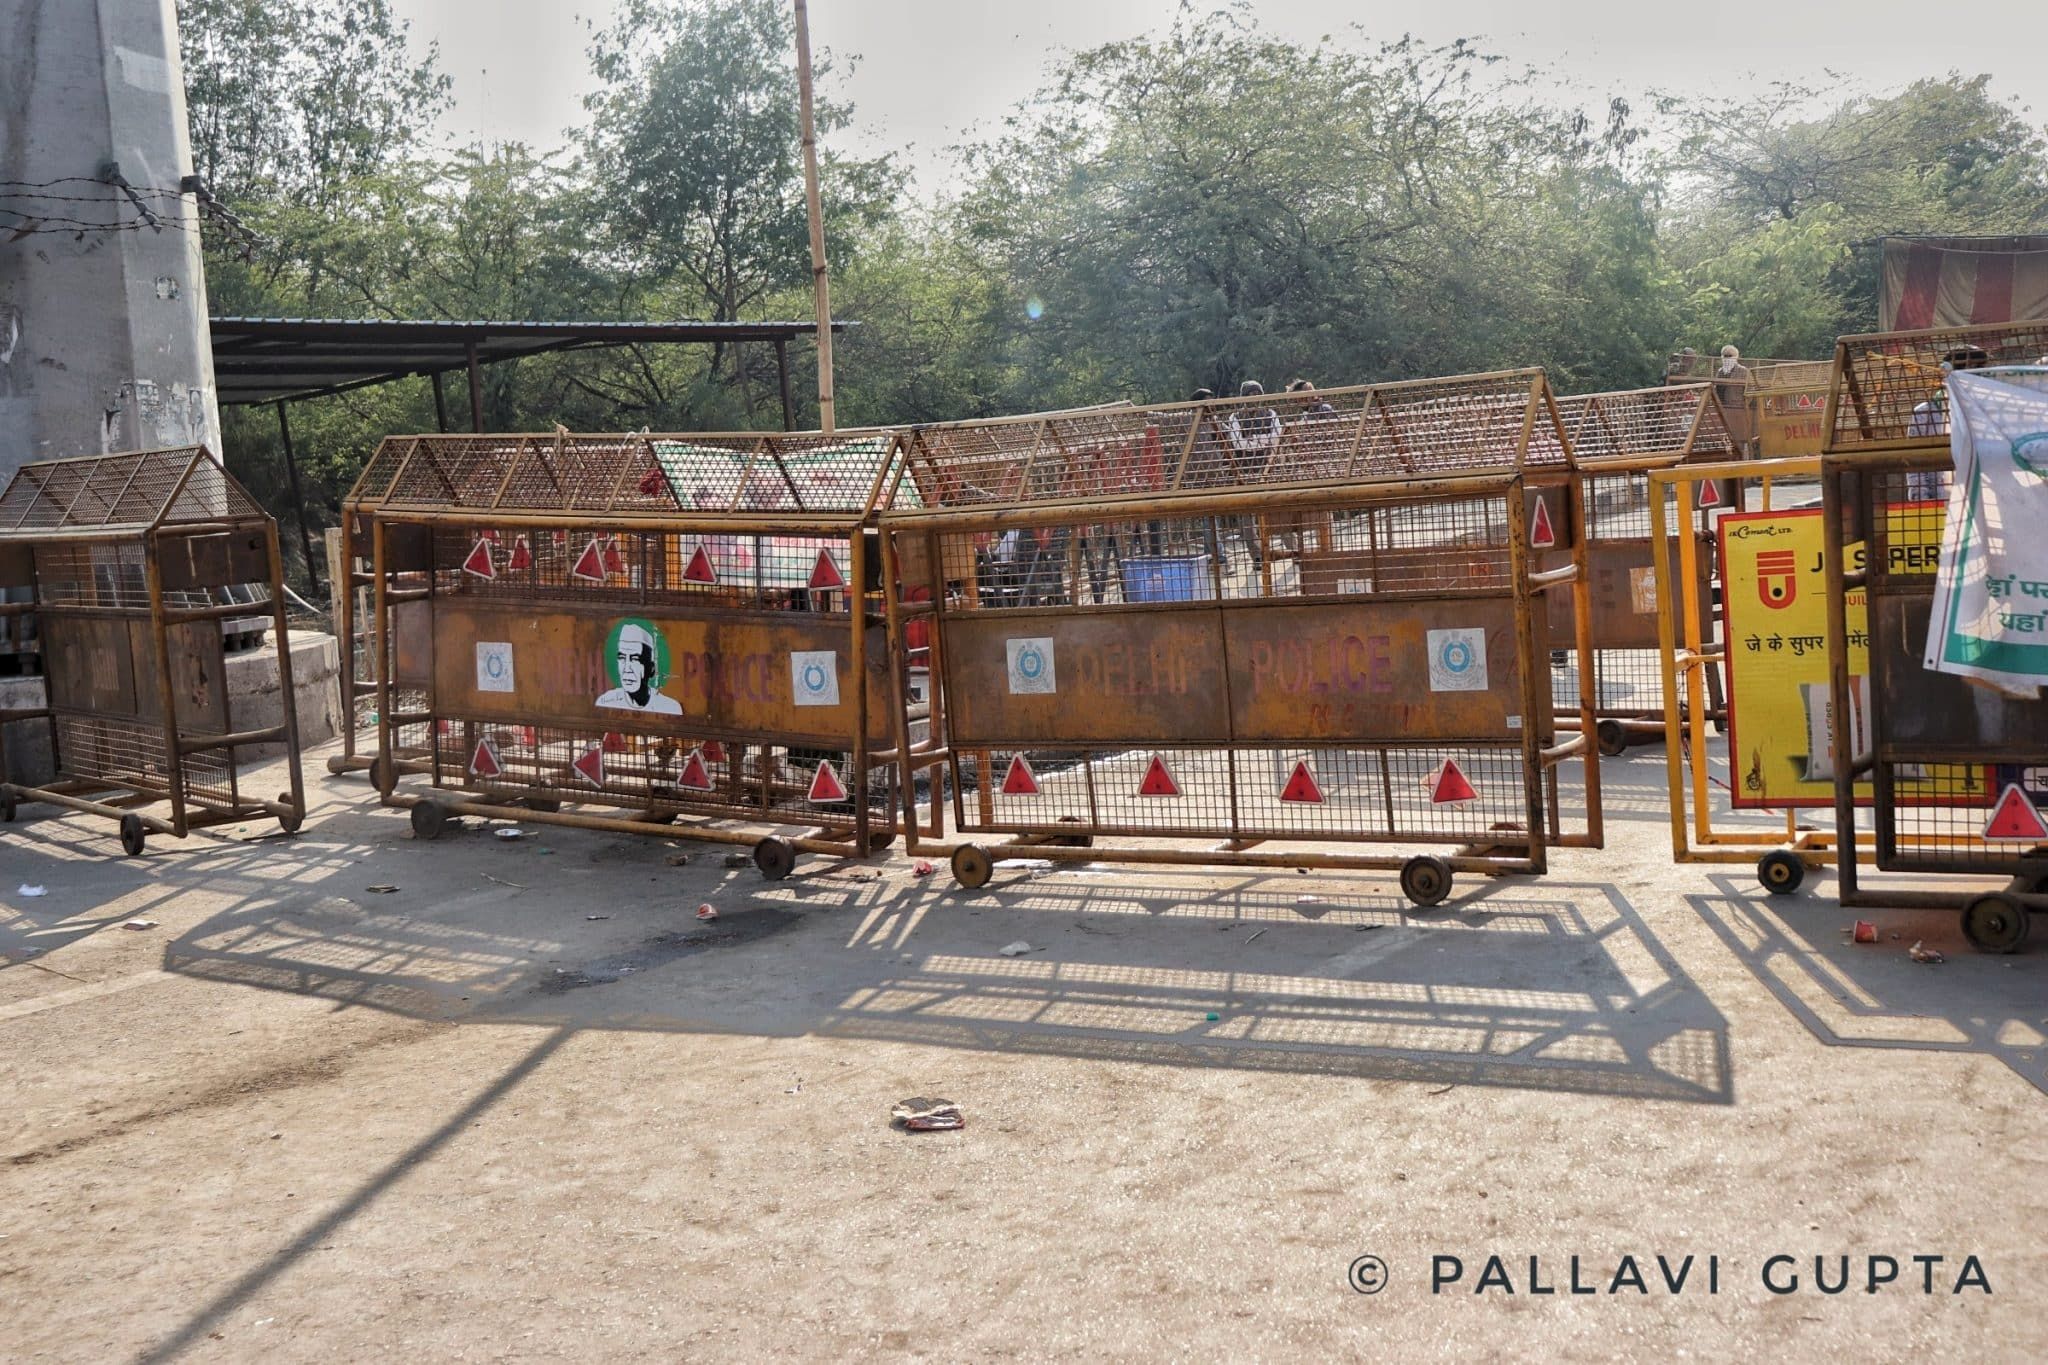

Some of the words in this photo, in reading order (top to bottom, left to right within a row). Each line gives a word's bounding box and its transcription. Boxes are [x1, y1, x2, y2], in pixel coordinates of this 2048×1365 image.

[1853, 545, 1940, 570] SPER
[1744, 633, 1761, 652] जे
[1766, 633, 1783, 651] के
[1787, 636, 1825, 656] सुपर
[1252, 635, 1393, 694] POLICE
